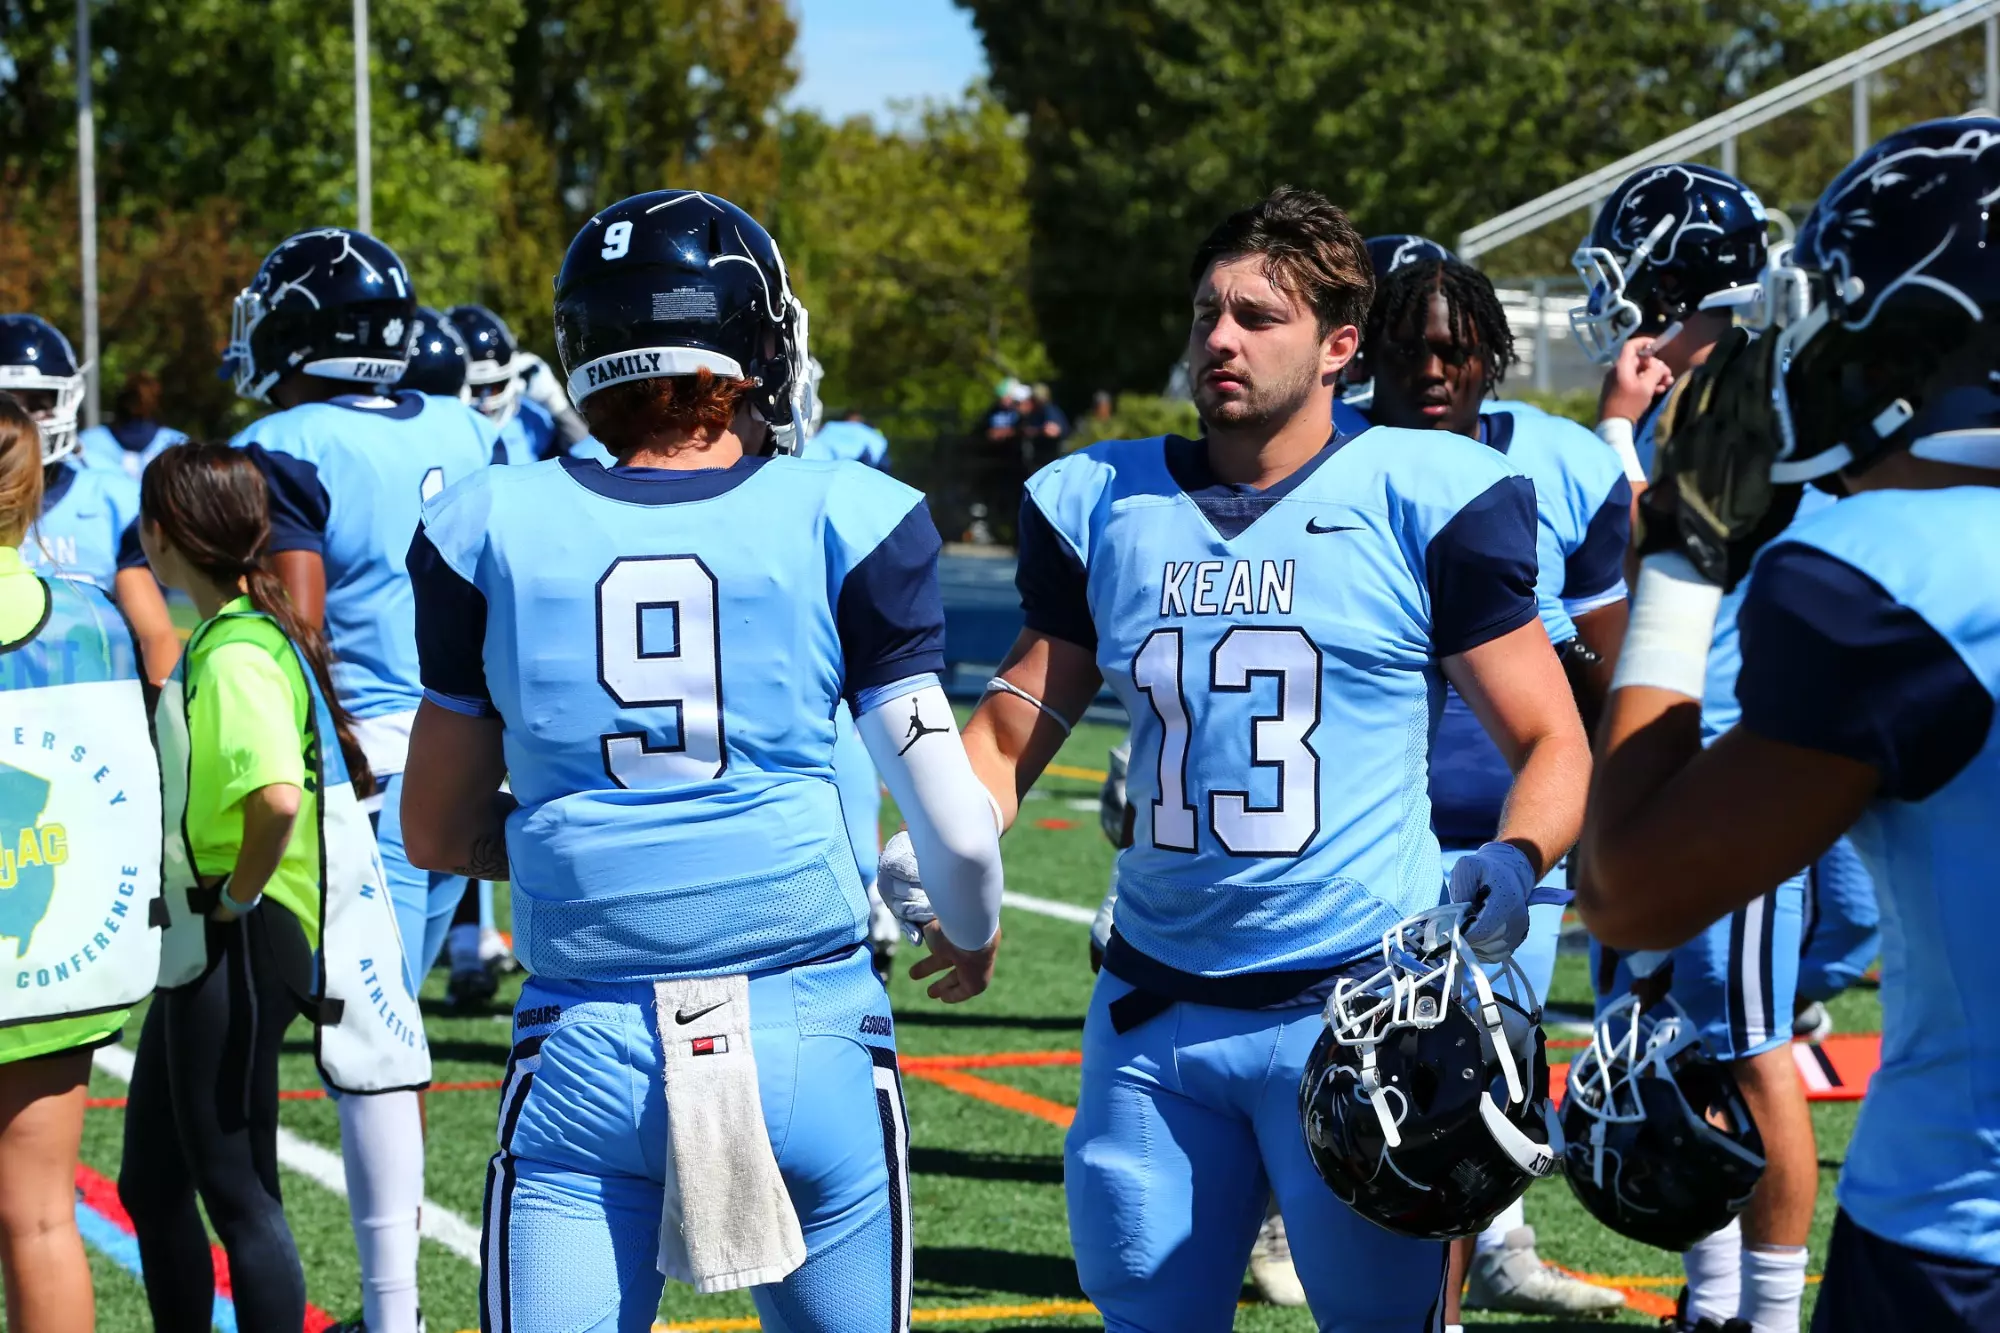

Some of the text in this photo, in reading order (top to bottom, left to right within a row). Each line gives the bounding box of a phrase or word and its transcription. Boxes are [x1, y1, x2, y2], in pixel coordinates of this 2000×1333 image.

[601, 220, 634, 261] 9
[387, 267, 407, 298] 1
[585, 352, 661, 387] FAMILY
[19, 535, 79, 567] EAN
[1161, 558, 1295, 616] KEAN
[594, 553, 728, 790] 9
[13, 726, 128, 806] ERSEY
[1131, 624, 1323, 858] 13
[0, 822, 69, 889] JAC
[15, 865, 138, 989] CONFERENCE
[359, 961, 415, 1048] ATHLETIC
[516, 1003, 562, 1031] COUGARS
